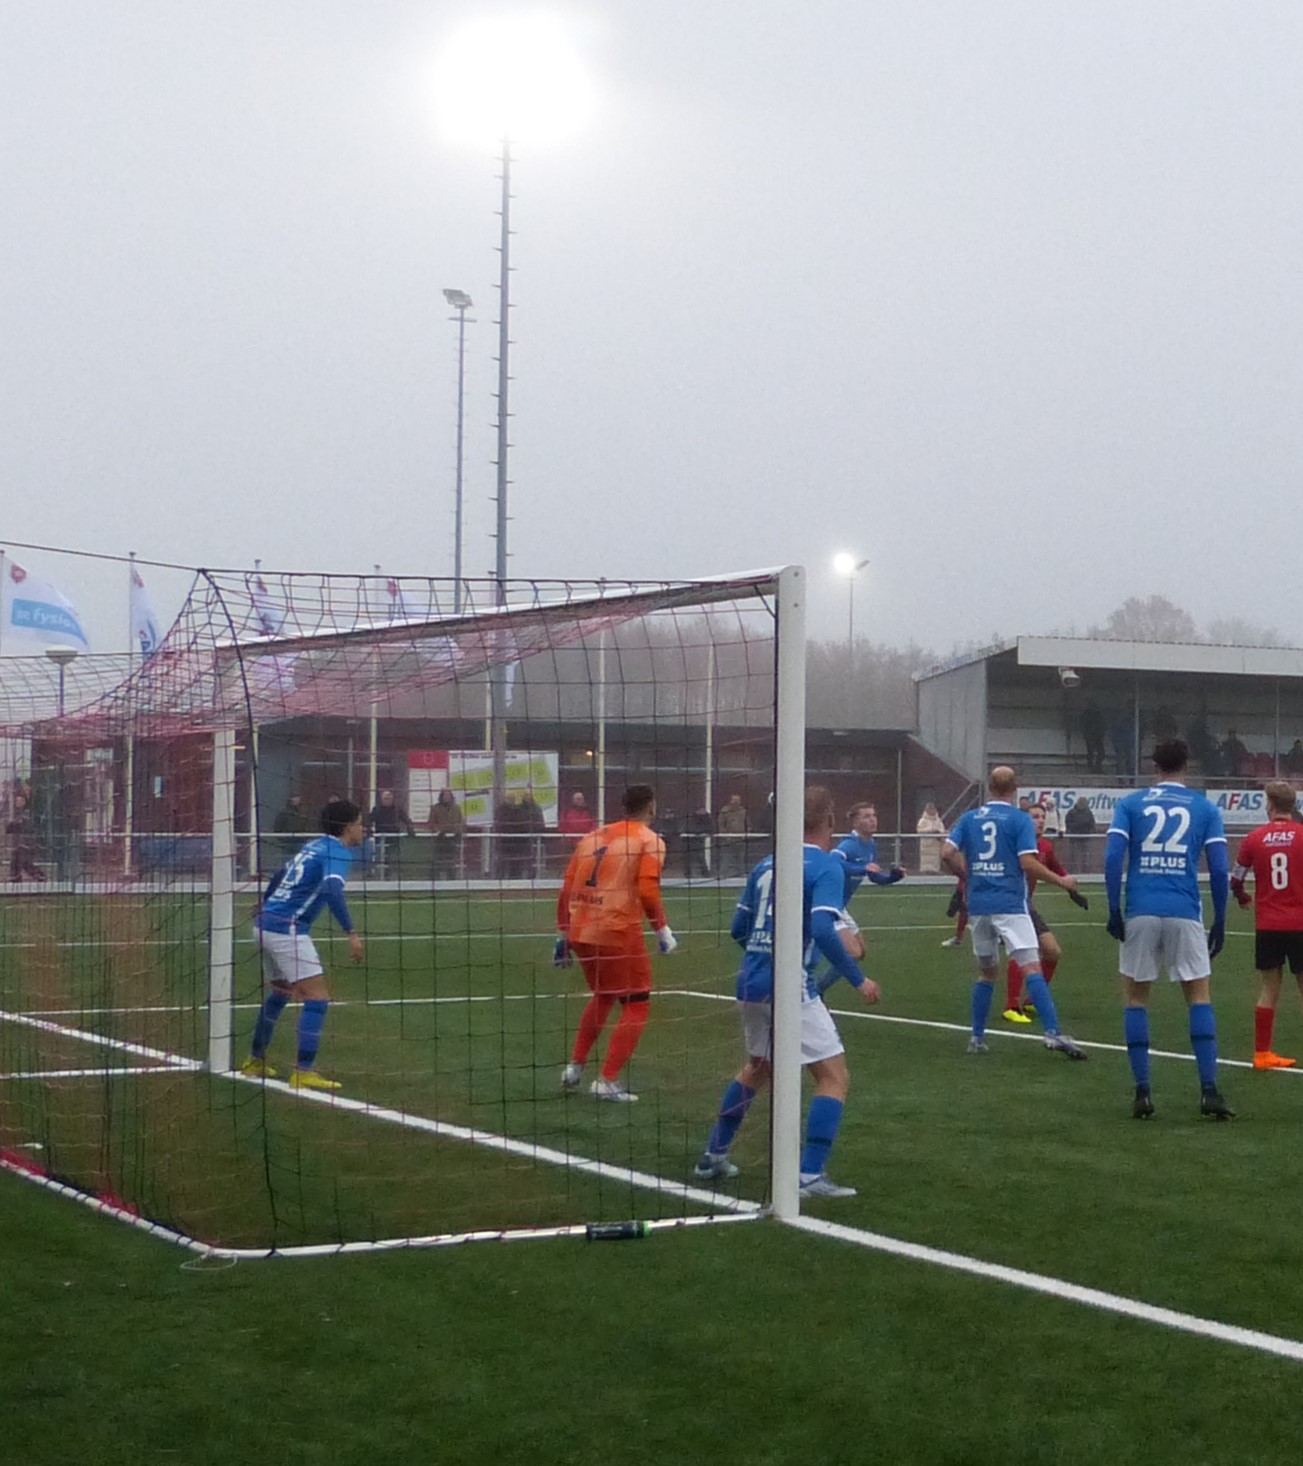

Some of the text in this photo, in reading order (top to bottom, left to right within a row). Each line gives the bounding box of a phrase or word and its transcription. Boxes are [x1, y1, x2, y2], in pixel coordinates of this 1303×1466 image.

[1217, 793, 1263, 811] AFAS
[979, 821, 997, 860] 3
[1142, 805, 1191, 853] 22
[1263, 831, 1295, 844] AFAS
[585, 846, 608, 887] 1
[1150, 857, 1186, 868] PLUS
[1271, 852, 1288, 890] 8
